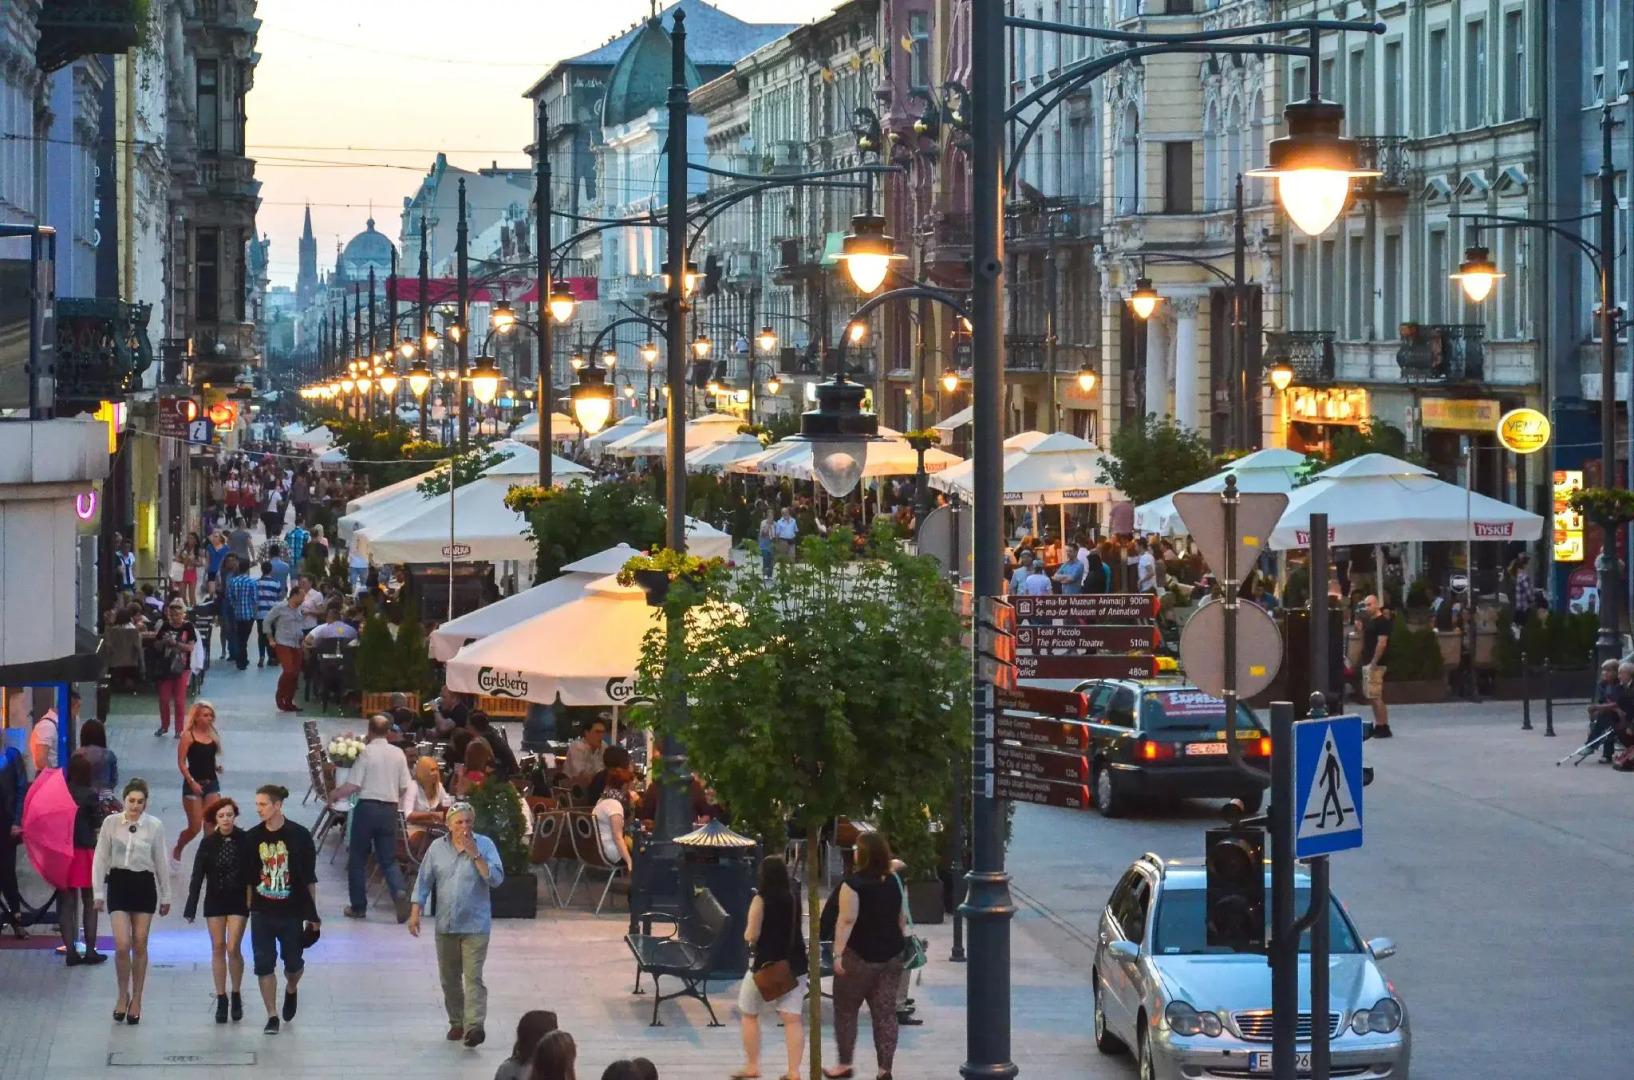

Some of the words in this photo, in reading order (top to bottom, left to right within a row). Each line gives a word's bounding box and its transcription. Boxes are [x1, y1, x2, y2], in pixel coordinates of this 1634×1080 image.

[1476, 524, 1510, 534] TYSKIE
[1036, 597, 1068, 606] Se-ma-for
[1098, 598, 1126, 607] Animacji
[1036, 608, 1068, 616] Se-ma-for
[1057, 628, 1080, 636] Piccolo
[1052, 638, 1075, 647] Piccolo
[1016, 658, 1038, 666] Policja
[478, 666, 528, 696] Carlsberg
